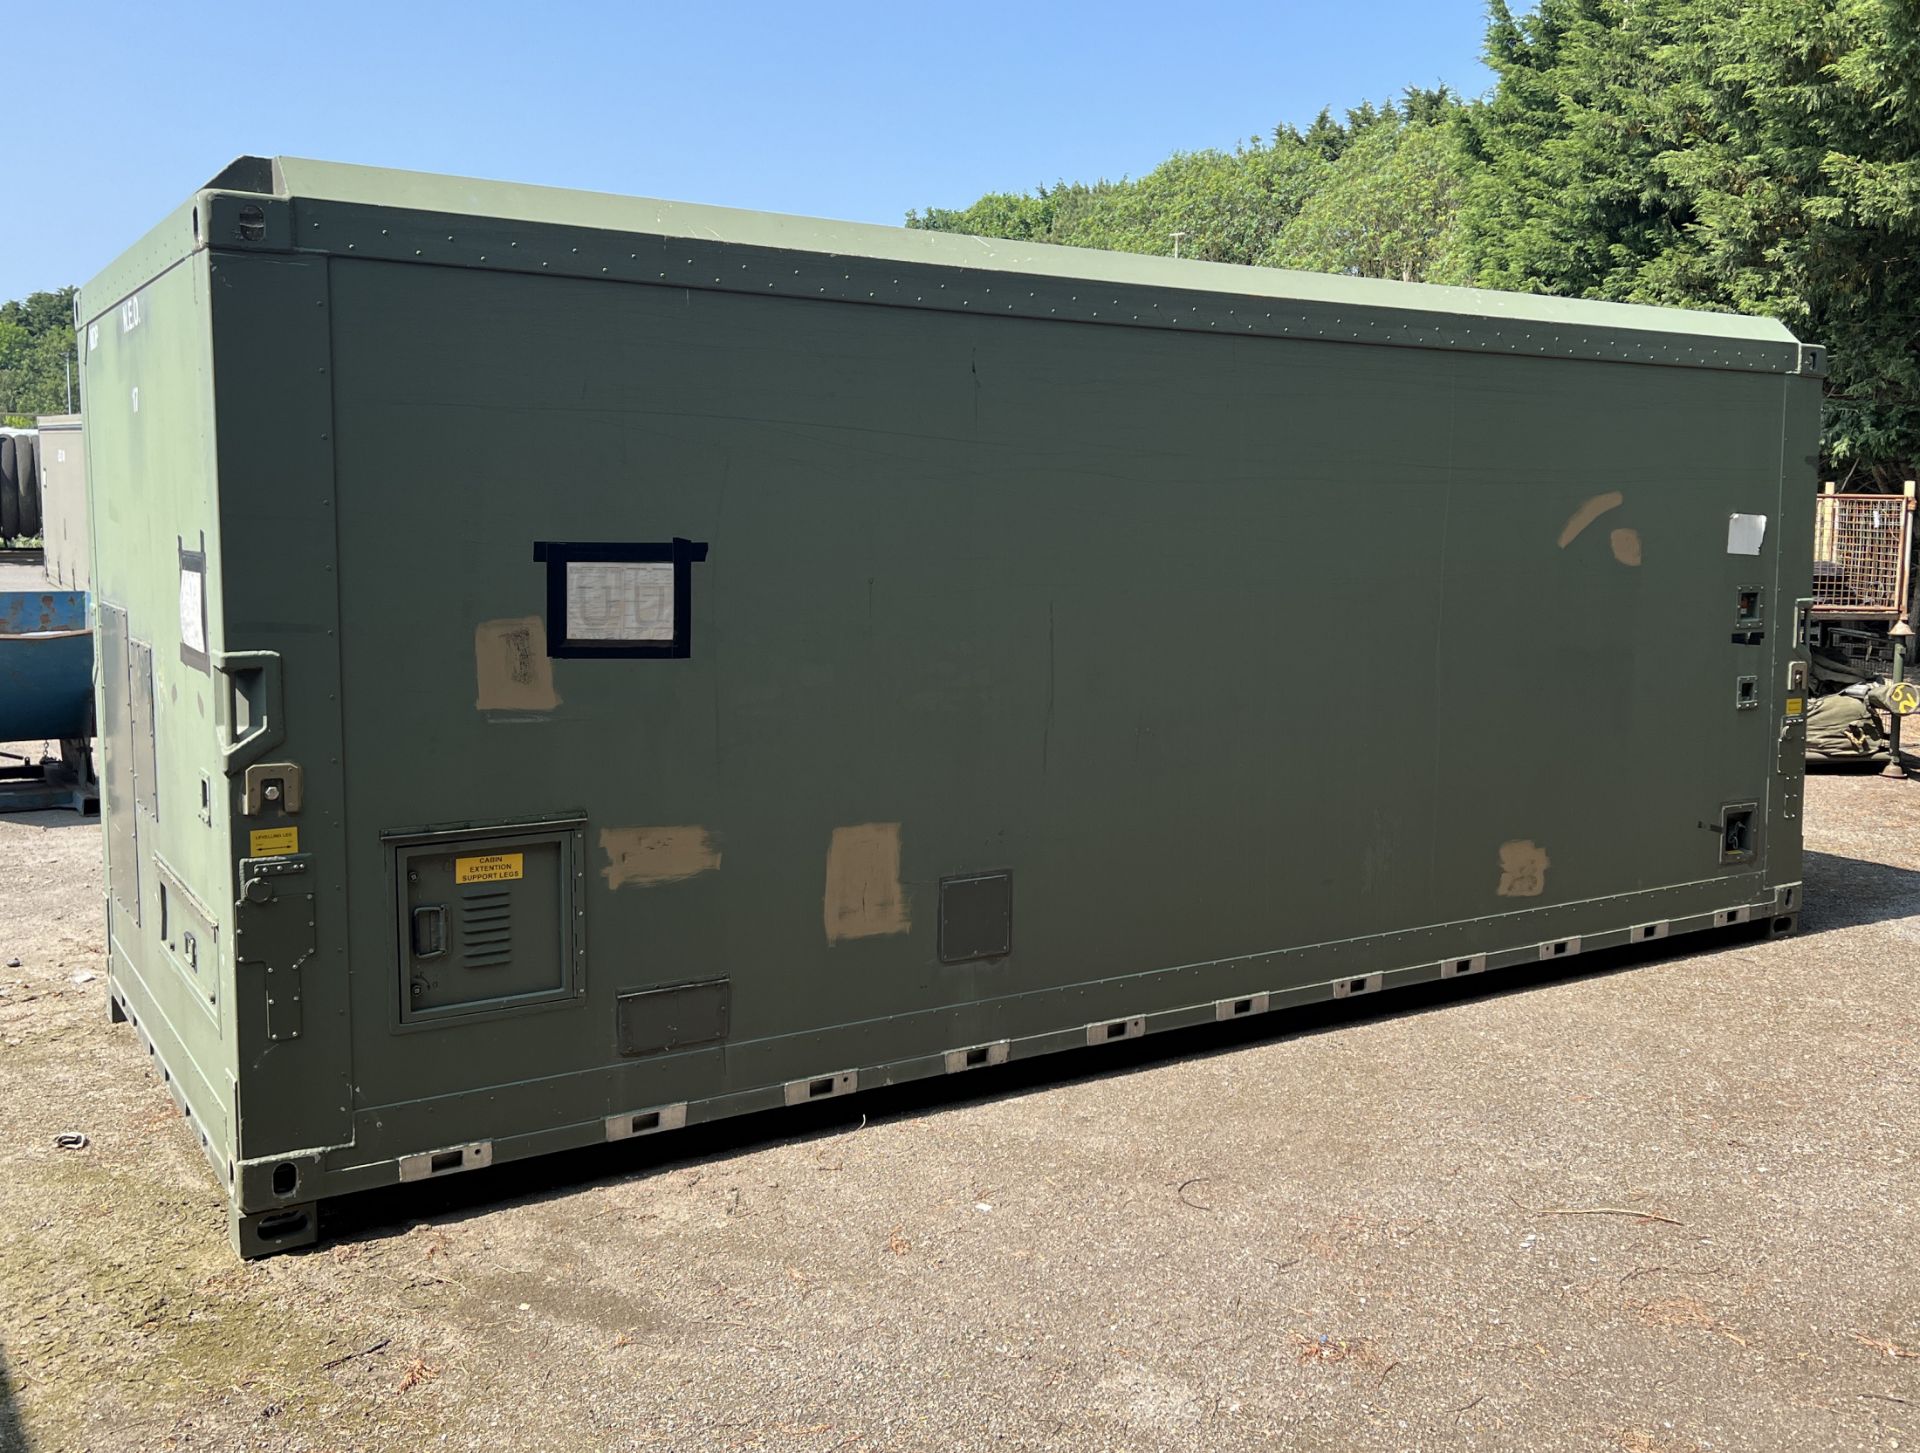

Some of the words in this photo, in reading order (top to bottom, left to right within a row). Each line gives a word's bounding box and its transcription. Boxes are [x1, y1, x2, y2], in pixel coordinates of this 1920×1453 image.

[469, 864, 512, 873] EXTENTION
[462, 873, 498, 882] SUPPORT
[499, 870, 519, 879] LEGS
